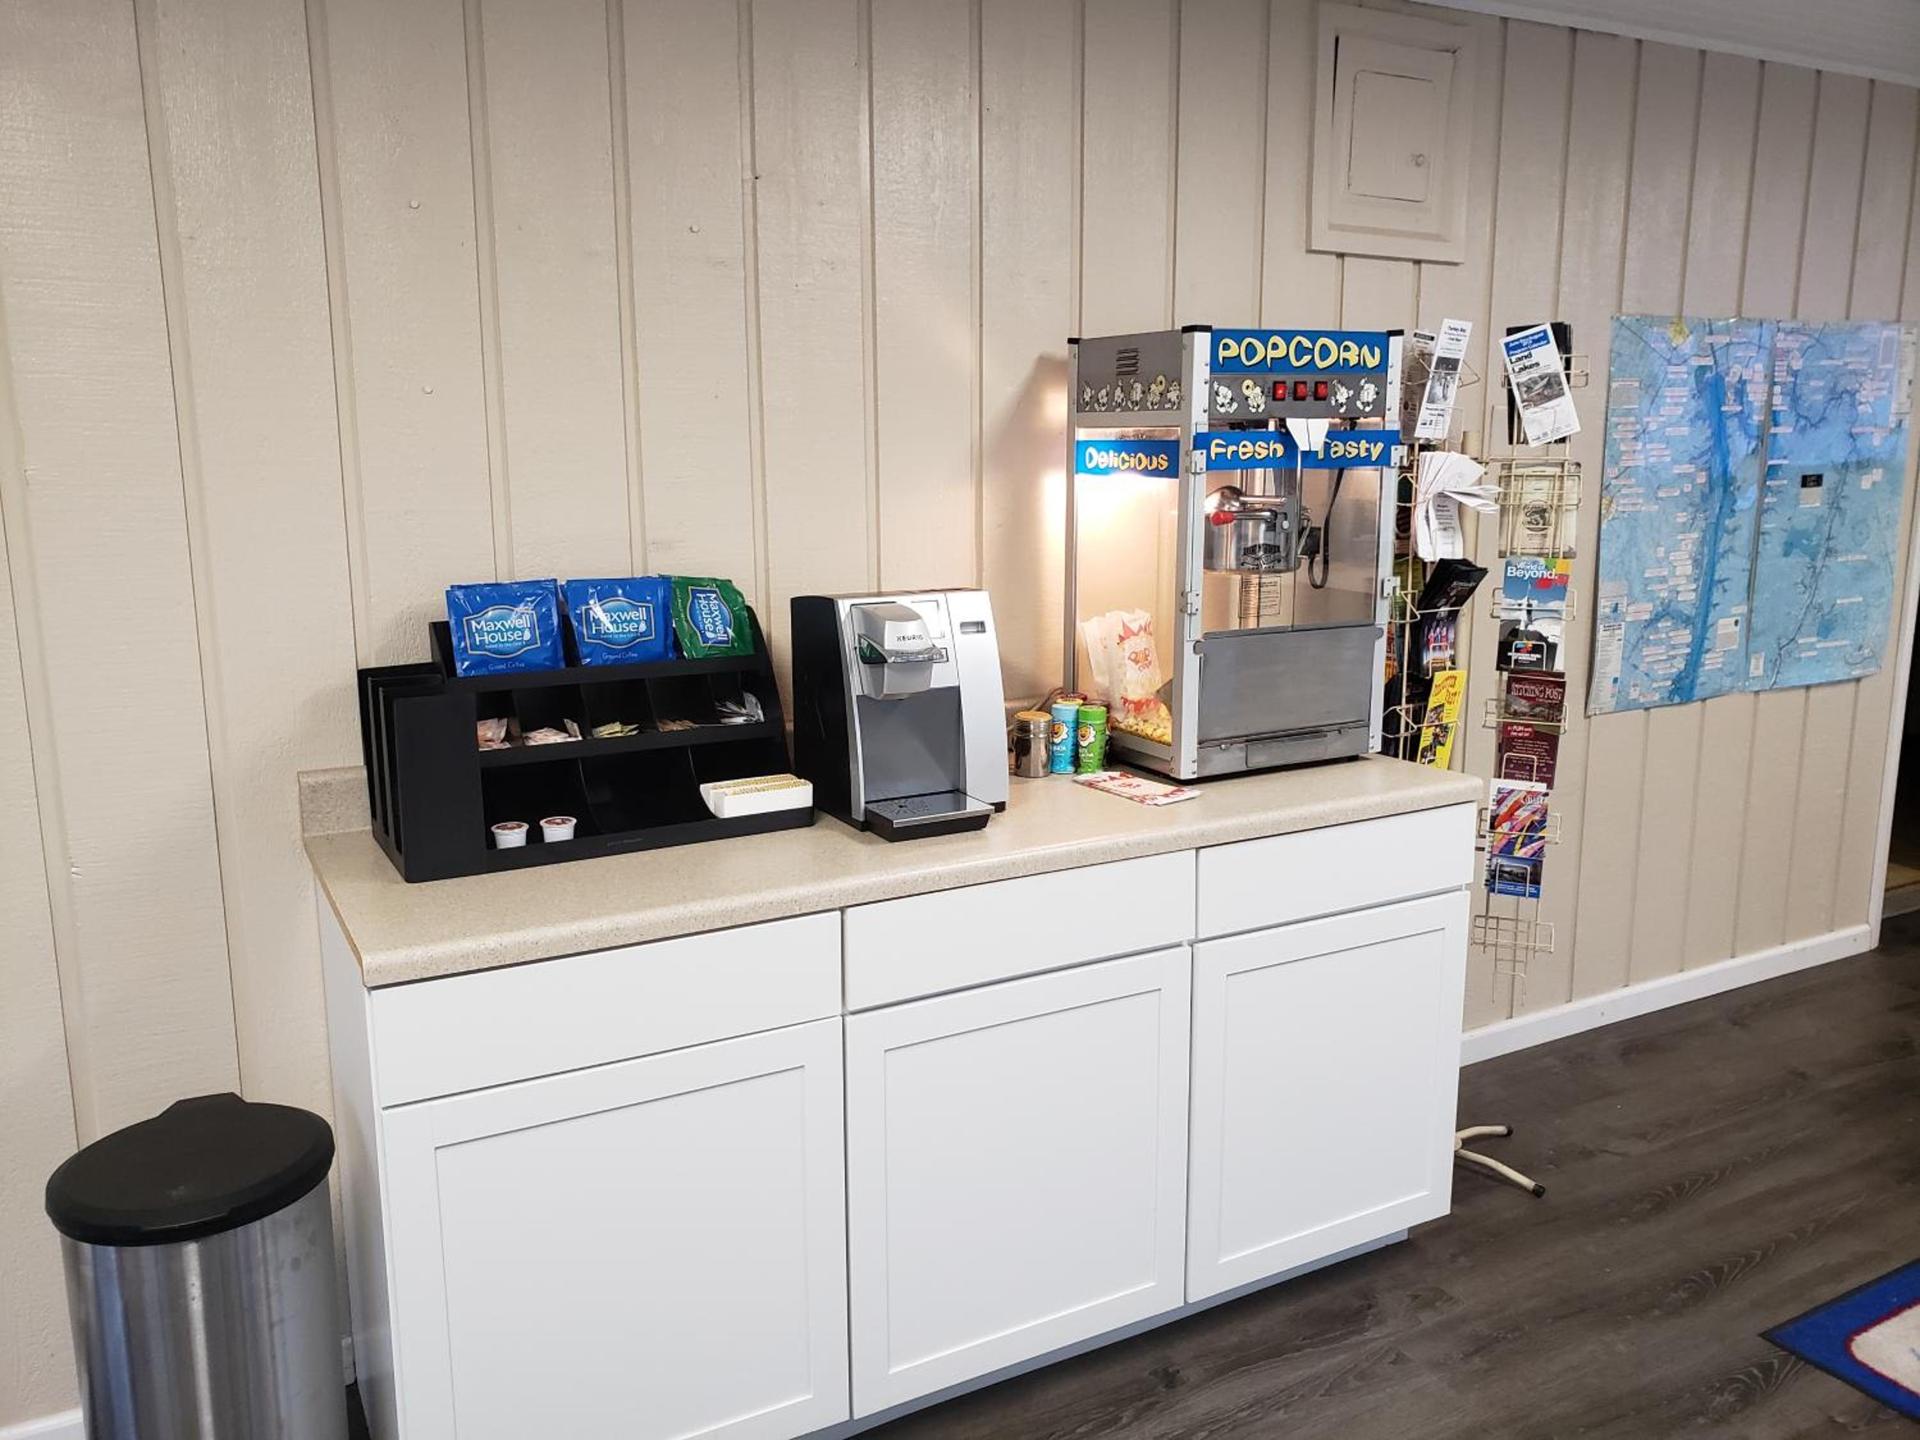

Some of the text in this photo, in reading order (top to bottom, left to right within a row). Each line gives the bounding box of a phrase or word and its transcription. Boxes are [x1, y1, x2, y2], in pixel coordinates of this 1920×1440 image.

[1218, 335, 1381, 369] POPCORN
[1509, 352, 1533, 364] Land
[1512, 362, 1540, 373] Lakes
[1210, 438, 1284, 461] Fresh
[1085, 446, 1169, 471] Delicious
[589, 607, 647, 622] Maxwell
[696, 593, 714, 631] House
[707, 593, 729, 640] Maxwell
[471, 614, 531, 633] Maxwell
[592, 622, 639, 634] House
[474, 630, 523, 645] House
[1545, 686, 1563, 700] POST
